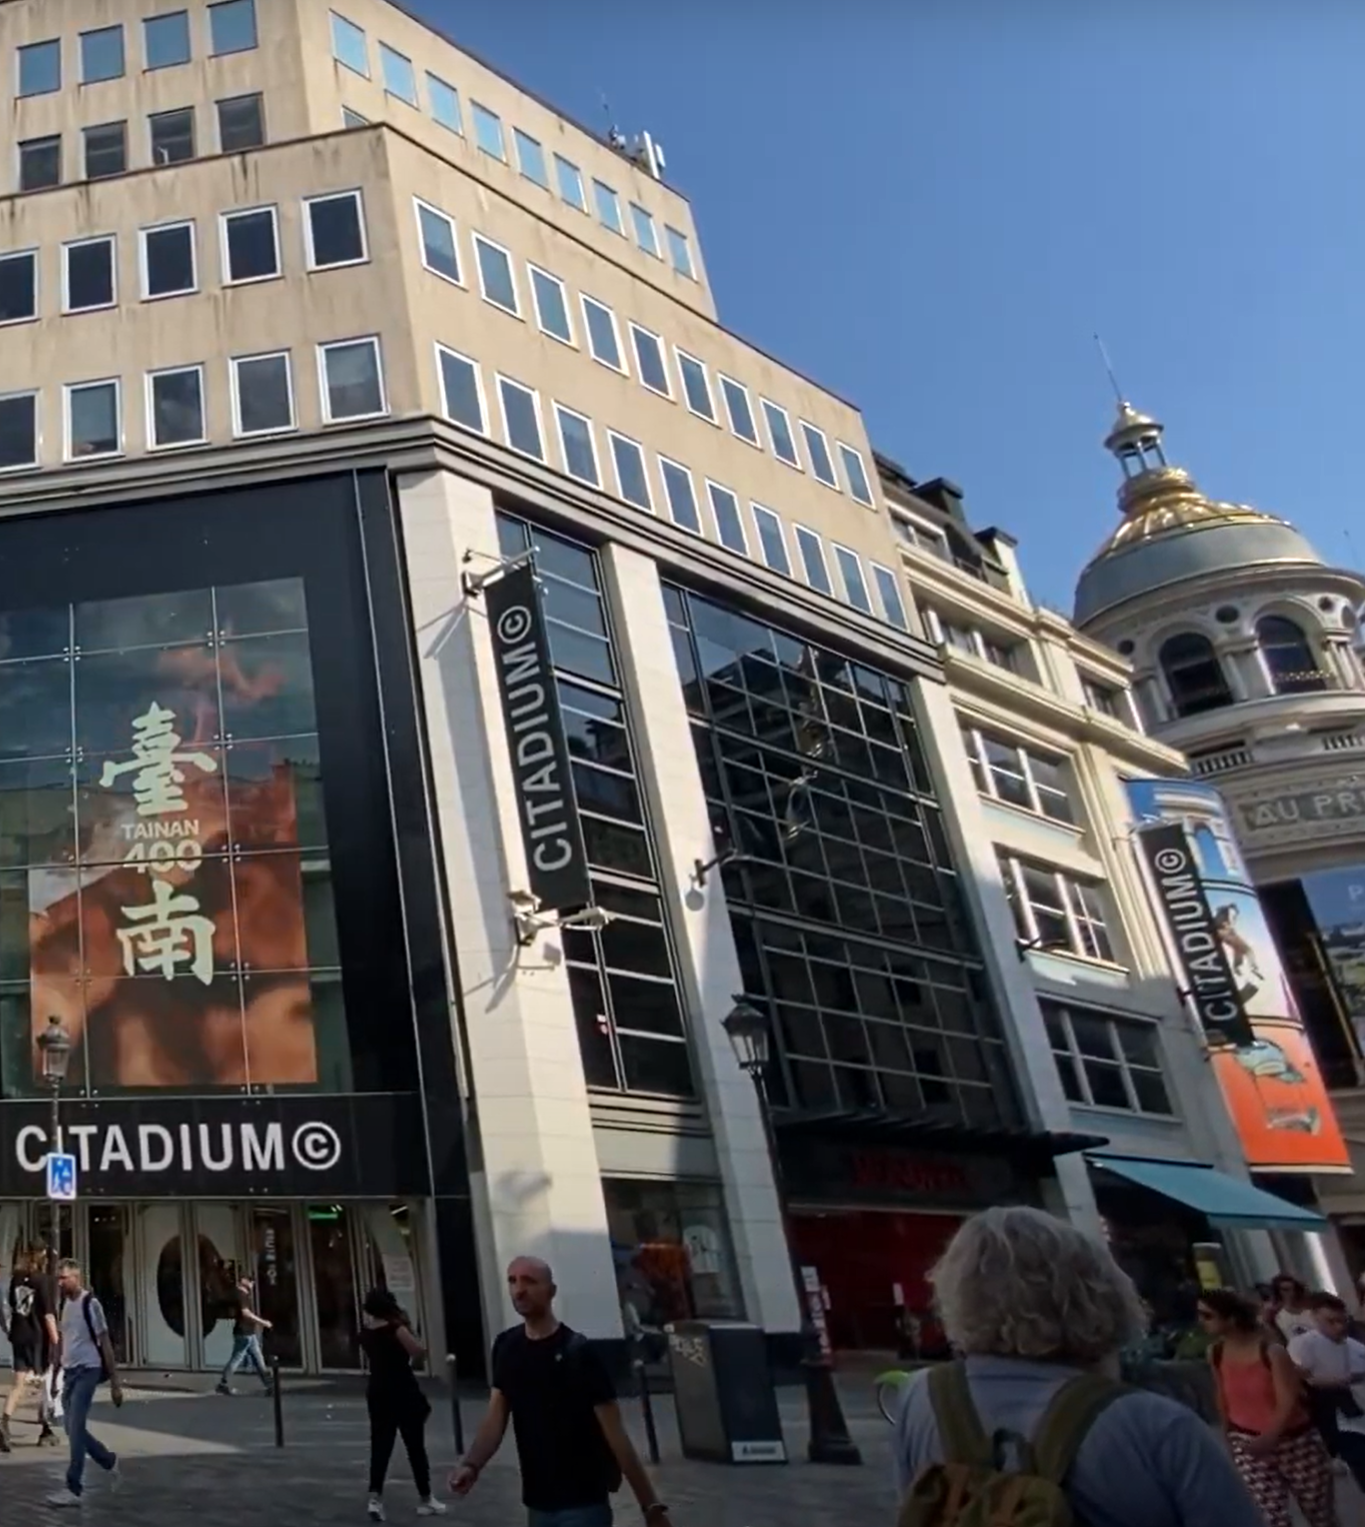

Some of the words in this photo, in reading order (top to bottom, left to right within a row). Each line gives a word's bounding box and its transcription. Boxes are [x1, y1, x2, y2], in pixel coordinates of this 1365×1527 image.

[99, 701, 217, 816] 臺
[1256, 799, 1299, 826] AU
[1312, 791, 1365, 816] PR
[120, 819, 199, 839] TAINAN
[123, 839, 203, 873] 400
[116, 879, 216, 985] 南
